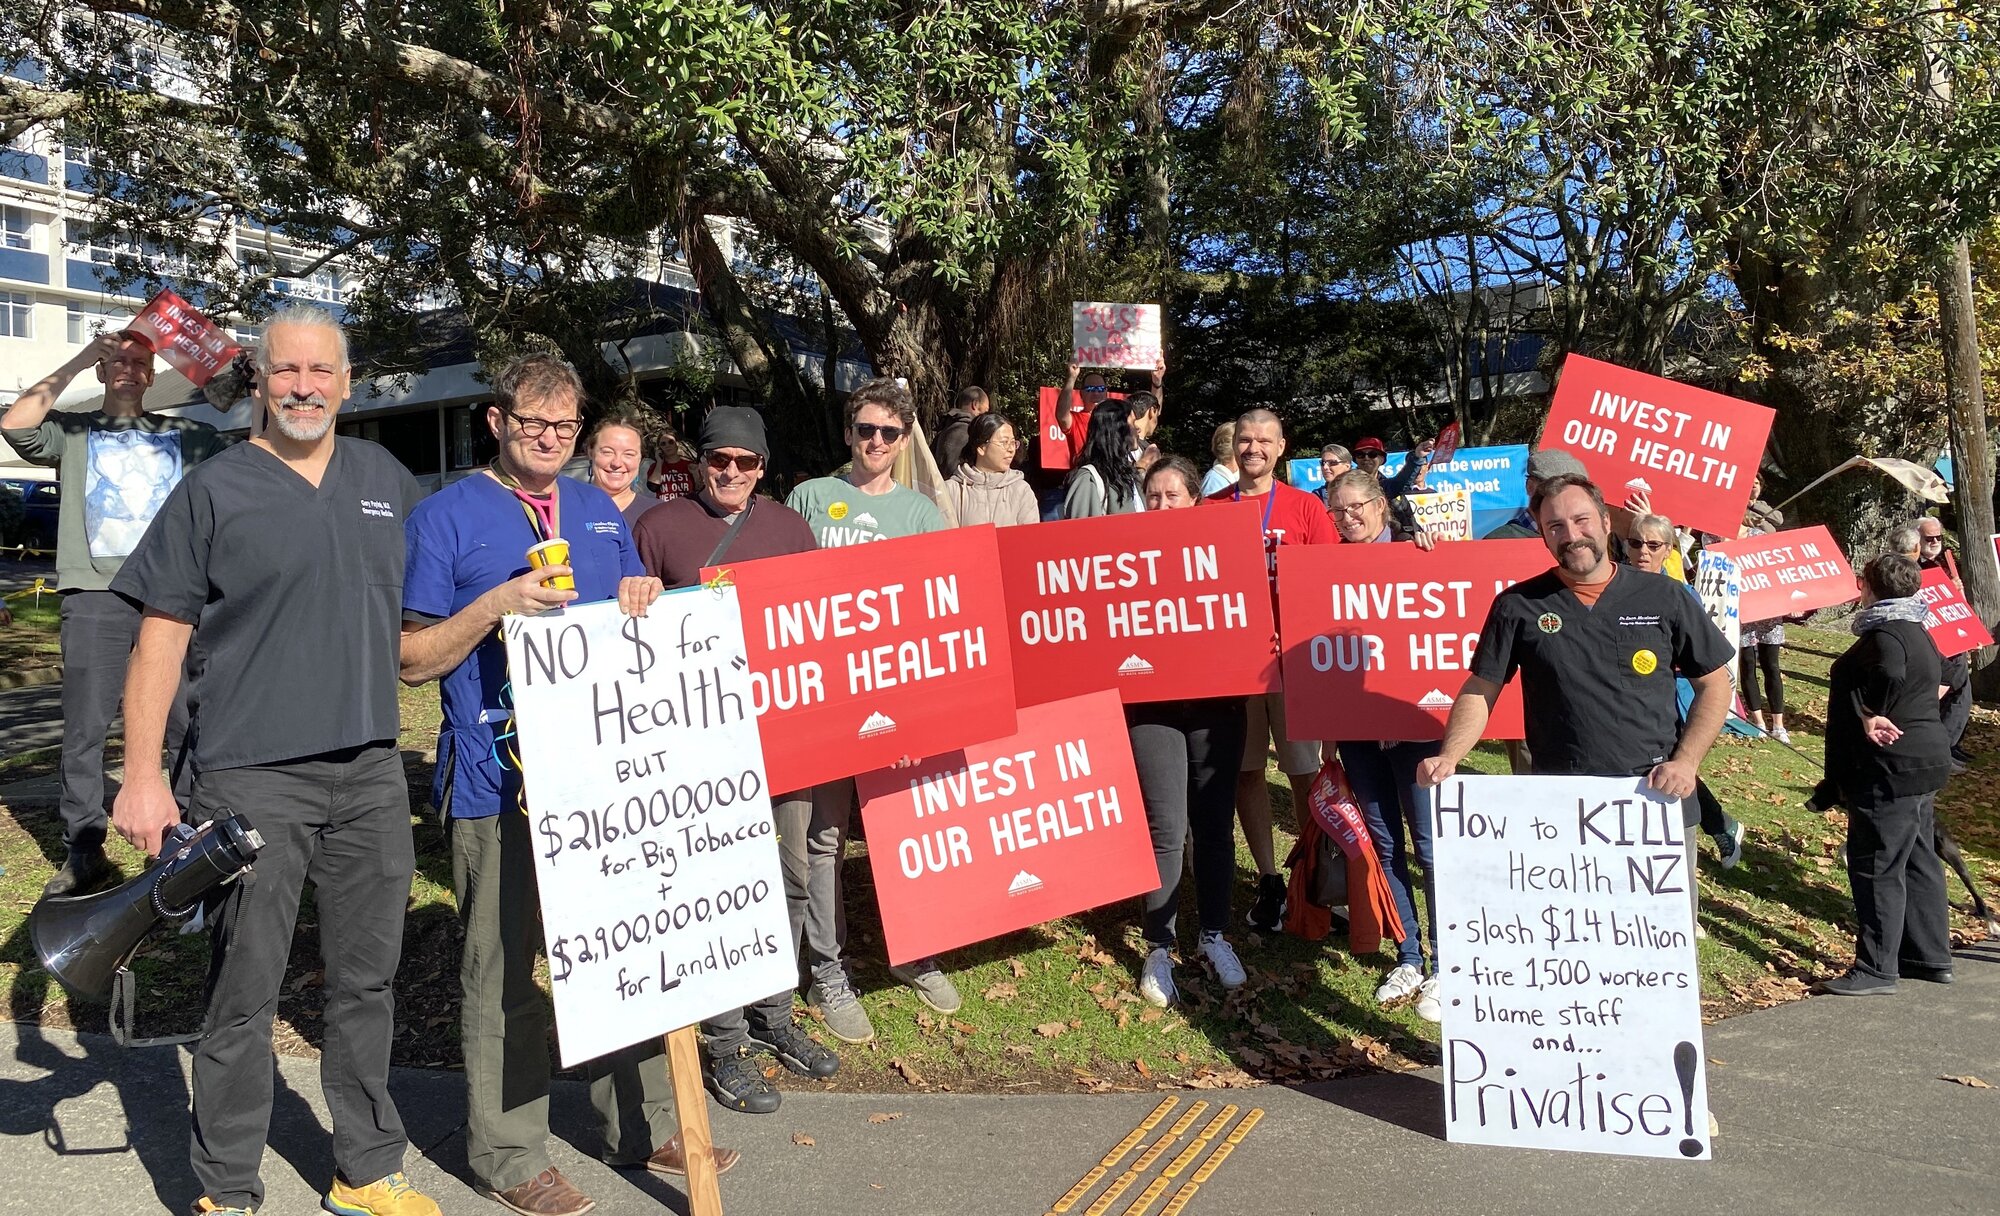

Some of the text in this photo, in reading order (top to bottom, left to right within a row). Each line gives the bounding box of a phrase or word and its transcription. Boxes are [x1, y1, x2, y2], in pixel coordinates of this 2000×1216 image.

[147, 312, 219, 370] OUR HEALTH
[166, 304, 226, 354] INVEST IN
[1082, 307, 1146, 333] JUST
[1107, 330, 1124, 345] A
[1049, 425, 1066, 440] OU
[1589, 389, 1732, 452] INVEST IN
[1450, 458, 1469, 472] be
[1471, 458, 1510, 471] worn
[1563, 419, 1738, 490] OUR HEALTH
[1409, 498, 1466, 515] Doctors
[1466, 478, 1500, 493] boat
[1036, 549, 1162, 596] INVEST
[1182, 544, 1219, 582] IN
[1735, 546, 1795, 572] INVEST
[1800, 542, 1821, 559] IN
[1738, 573, 1771, 593] OUR
[1776, 560, 1841, 585] HEALTH
[764, 574, 960, 651] INVEST IN
[1331, 581, 1473, 621] INVEST
[1936, 601, 1972, 623] HEALTH
[1937, 583, 1954, 599] IN
[1020, 592, 1248, 646] OUR HEALTH
[621, 614, 655, 684] $
[676, 613, 720, 659] for
[749, 626, 987, 716] OUR HEALTH
[1310, 633, 1481, 672] OUR HEA
[616, 750, 667, 783] BUT
[910, 738, 1092, 818] INVEST IN
[538, 769, 762, 868] $216,000,000
[898, 785, 1123, 880] OUR HEALTH
[1435, 781, 1685, 846] How to KILL
[600, 821, 771, 878] for Big Tobacco
[1509, 850, 1685, 896] Health NZ
[552, 879, 769, 985] $2,900,000,000
[1466, 903, 1687, 951] slash $1.4 billion
[615, 928, 779, 1001] for Landlords
[1468, 956, 1689, 991] fire 1,500 workers
[1474, 994, 1624, 1027] blame staff
[1532, 1033, 1603, 1054] and...
[1448, 1038, 1704, 1158] Privatise!
